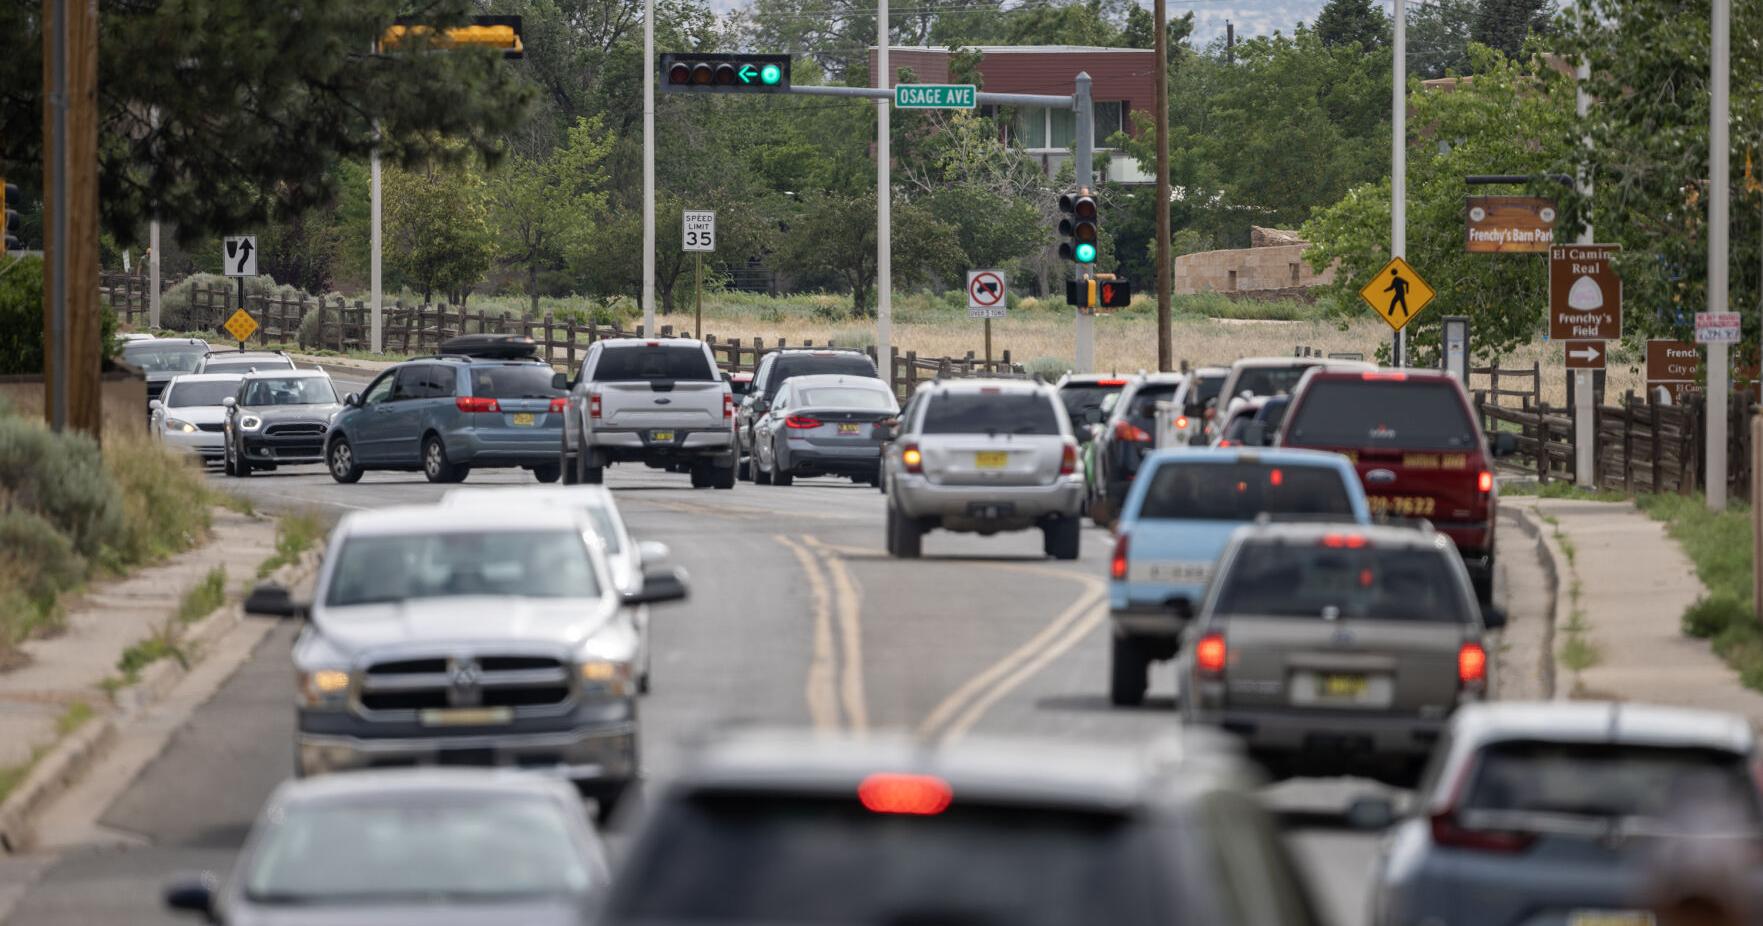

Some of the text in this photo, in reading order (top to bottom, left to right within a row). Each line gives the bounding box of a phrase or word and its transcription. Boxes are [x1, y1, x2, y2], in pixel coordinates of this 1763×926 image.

[900, 88, 971, 104] OSAGE AVE
[686, 231, 712, 246] 35
[1469, 228, 1511, 245] Frenchy's
[1512, 228, 1534, 242] Barn
[1553, 248, 1611, 260] El Camin
[1572, 262, 1600, 274] Real
[1559, 312, 1612, 325] Frenchy's
[1572, 325, 1599, 336] Field
[1668, 364, 1688, 376] City
